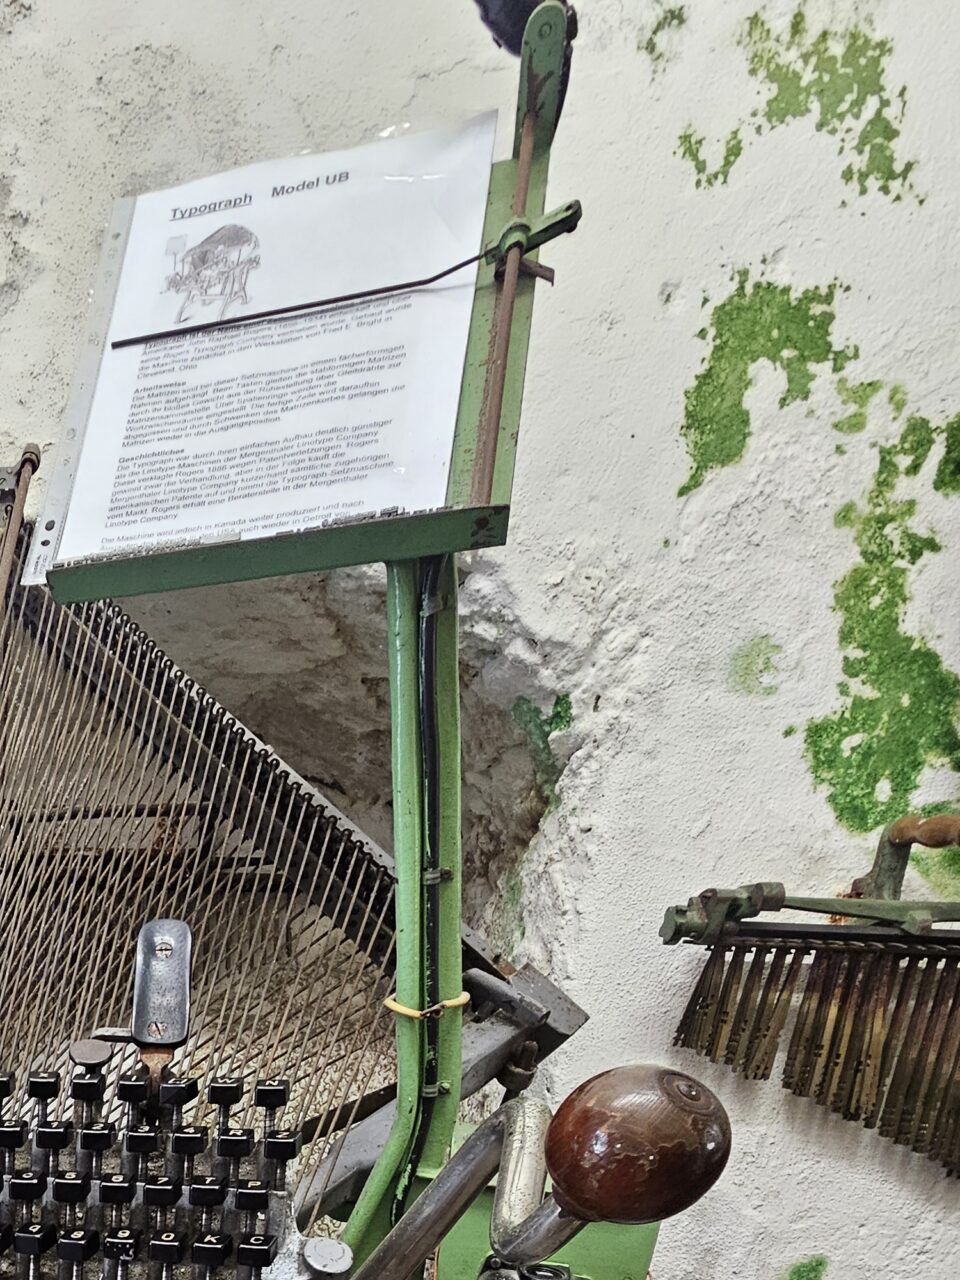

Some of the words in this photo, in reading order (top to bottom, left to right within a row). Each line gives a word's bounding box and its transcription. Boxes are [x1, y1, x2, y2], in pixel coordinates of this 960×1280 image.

[170, 193, 253, 220] Typograph
[271, 177, 320, 198] Model
[325, 171, 350, 186] UB
